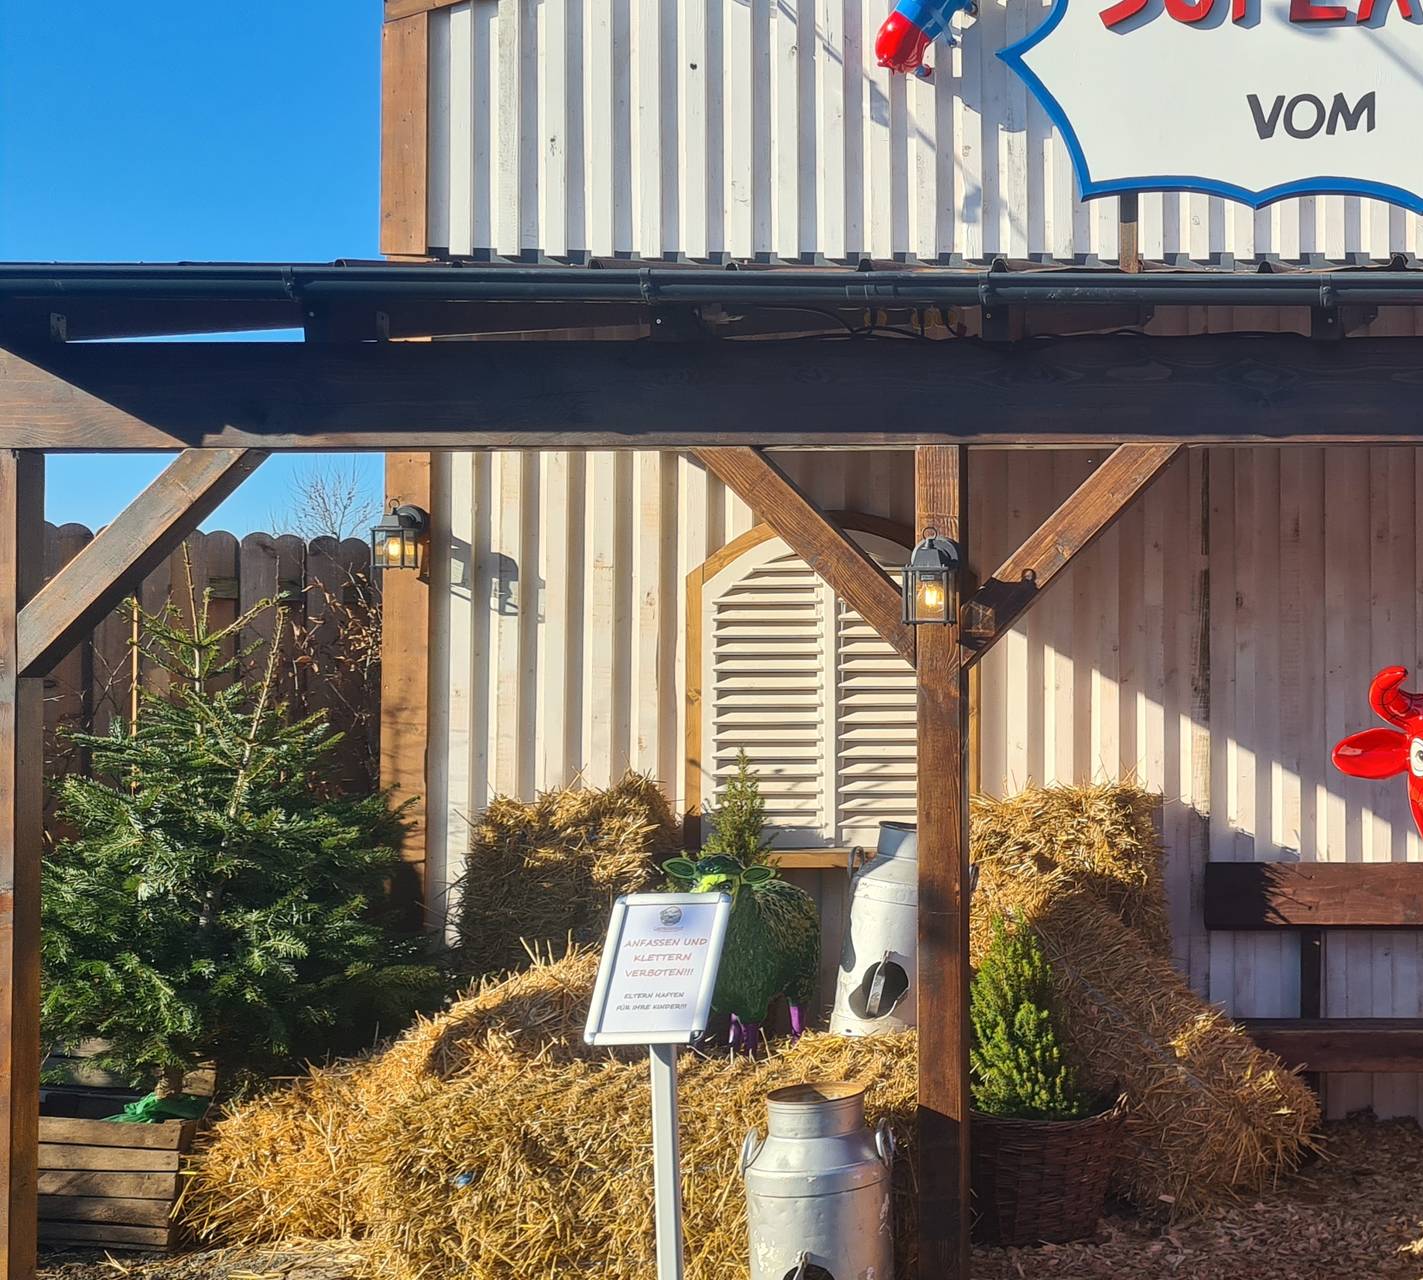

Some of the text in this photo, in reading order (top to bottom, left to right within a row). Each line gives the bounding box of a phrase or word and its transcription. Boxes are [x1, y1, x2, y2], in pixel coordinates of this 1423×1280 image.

[1245, 91, 1377, 141] VOM
[624, 938, 708, 947] ANFASSEN UND
[633, 953, 692, 962] KLETTERN
[625, 968, 694, 977] VERBOTEN!!!
